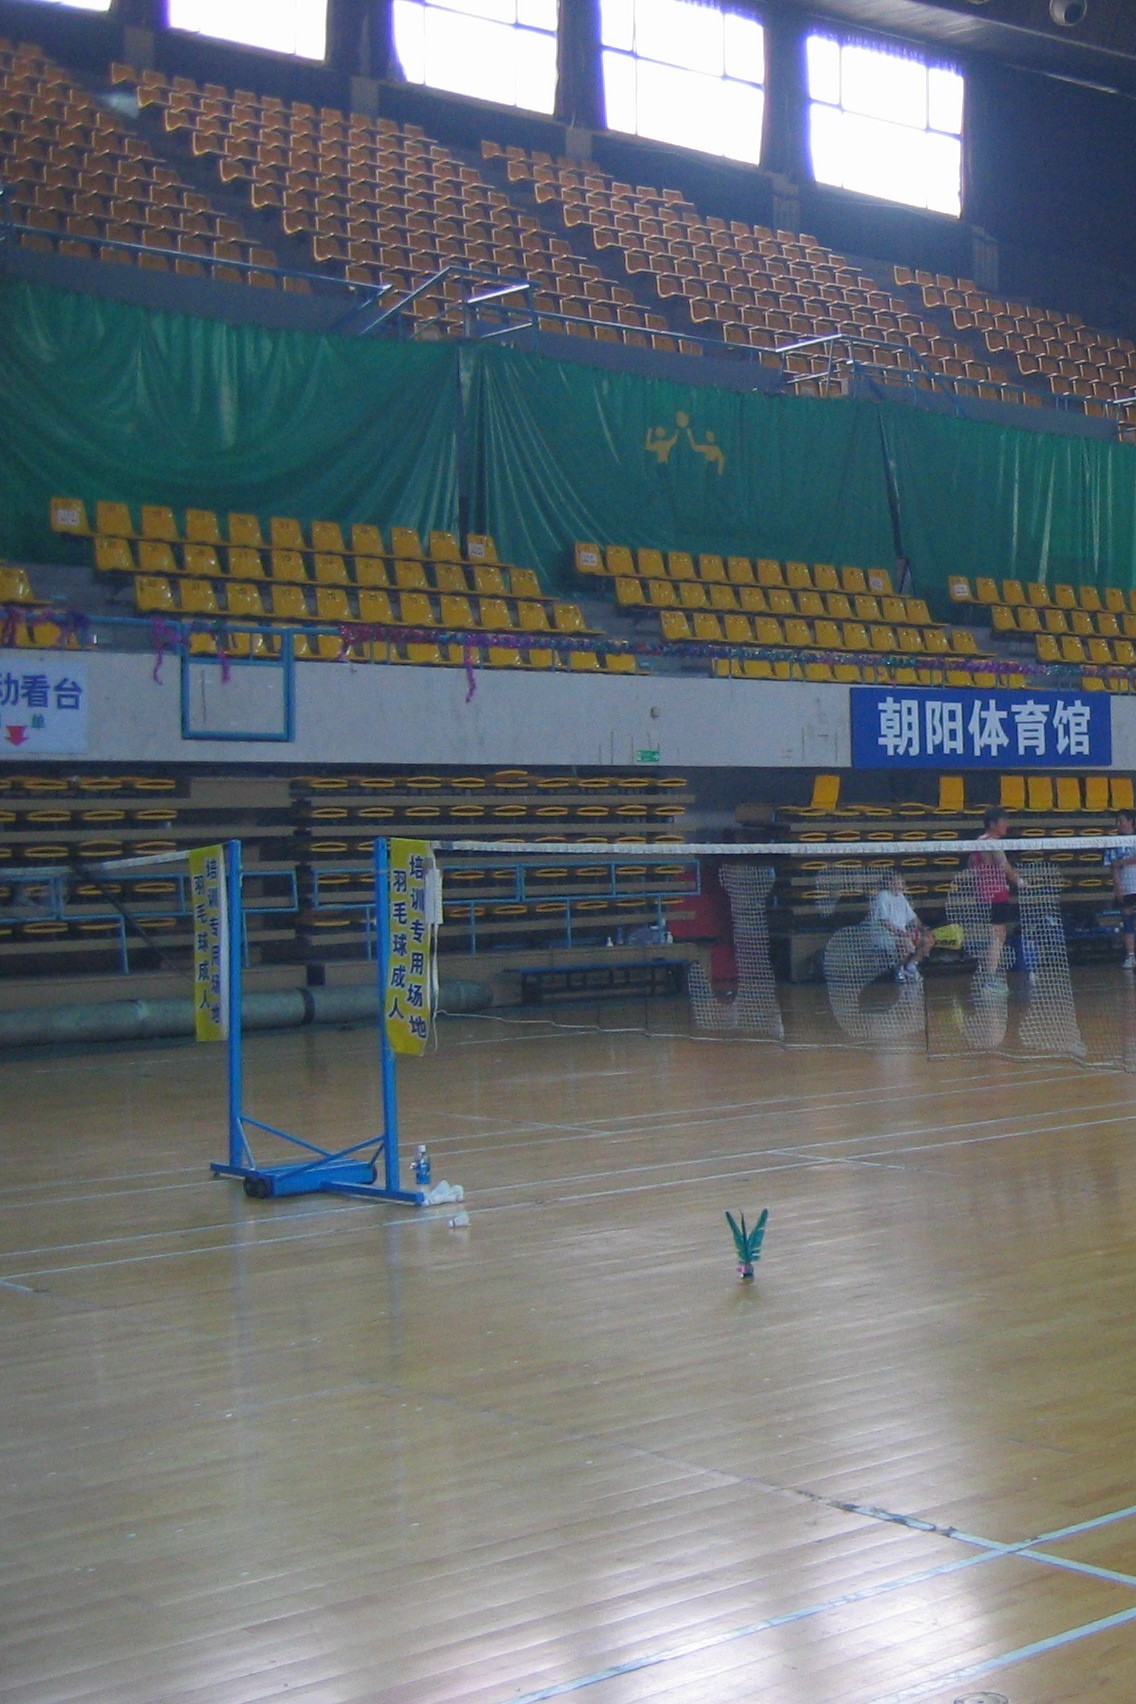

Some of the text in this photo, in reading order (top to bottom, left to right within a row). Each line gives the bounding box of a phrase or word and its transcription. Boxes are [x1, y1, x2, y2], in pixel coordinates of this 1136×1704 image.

[877, 697, 1091, 757] 朝阳体育馆
[387, 869, 408, 1020] 羽毛球成人
[406, 854, 428, 1039] 培训专用场地
